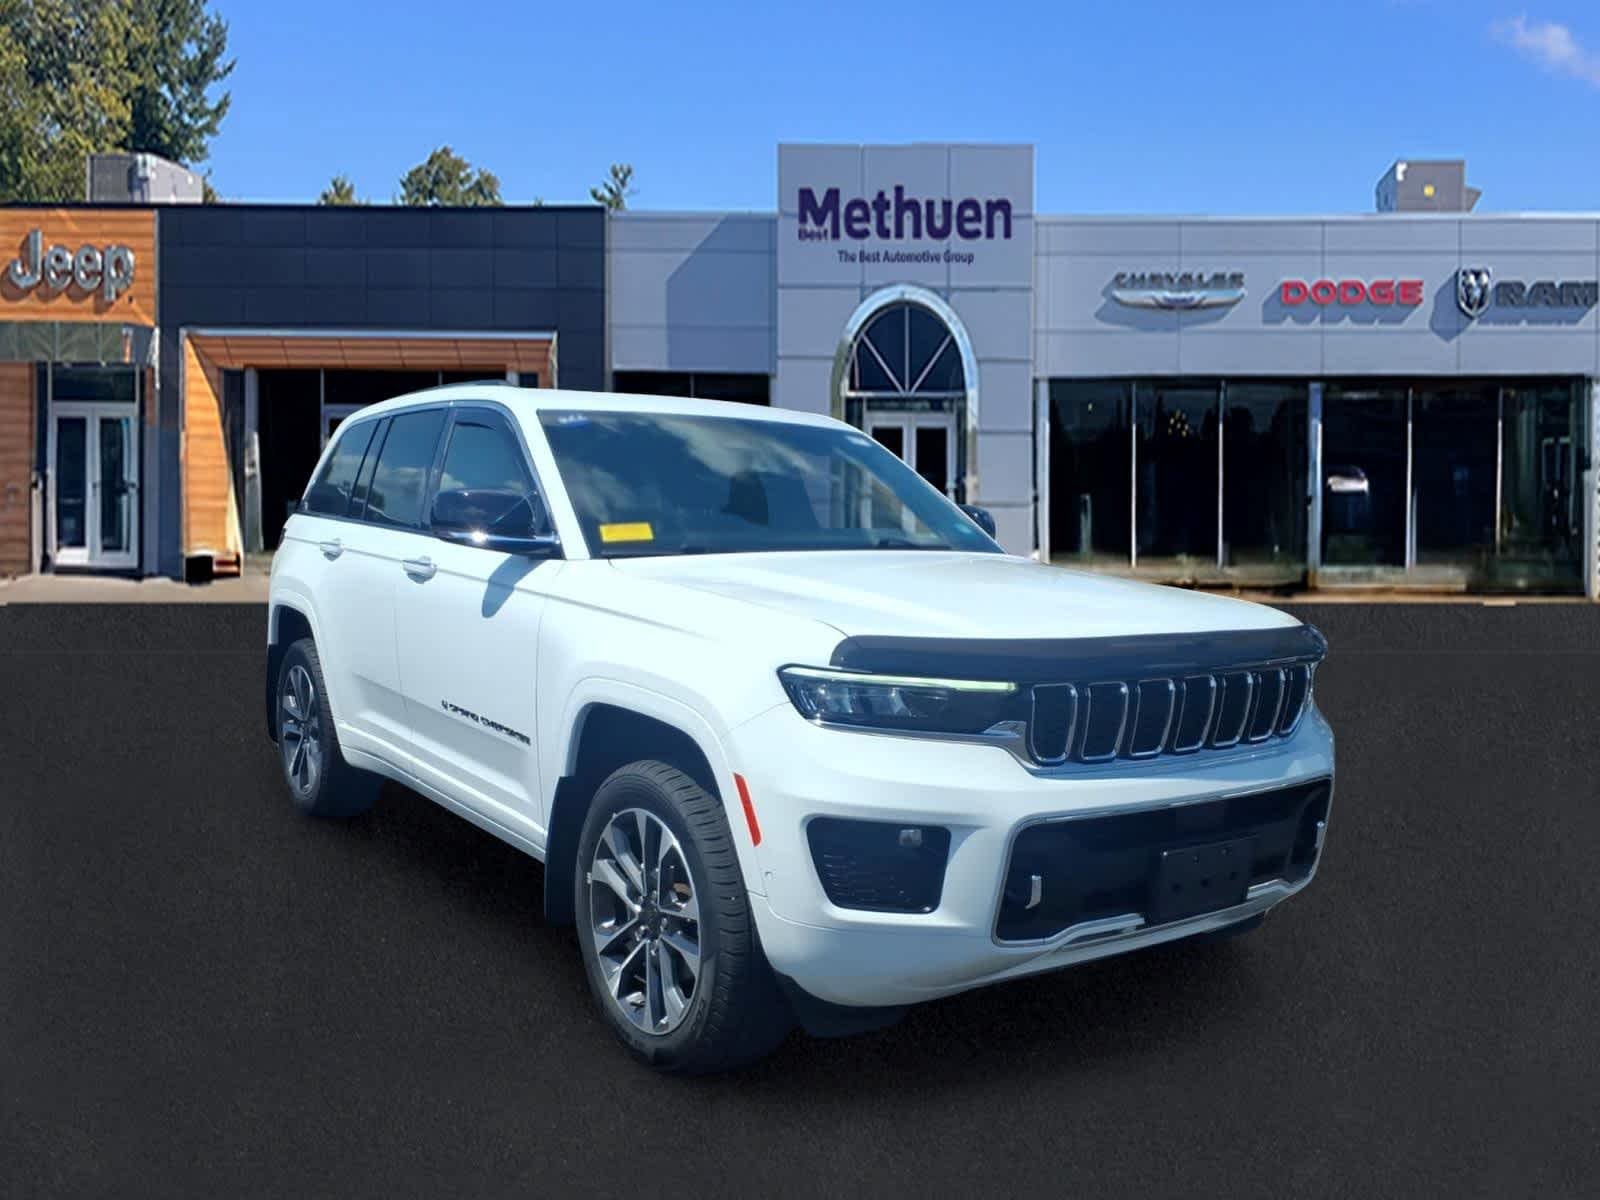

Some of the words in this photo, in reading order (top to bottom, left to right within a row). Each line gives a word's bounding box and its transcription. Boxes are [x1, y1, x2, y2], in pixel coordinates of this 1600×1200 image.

[798, 185, 1012, 240] Methuen
[798, 228, 829, 241] Best
[9, 229, 135, 301] Jeep
[838, 250, 857, 263] The
[859, 250, 880, 263] Best
[883, 250, 940, 263] Automotive
[943, 250, 974, 266] Group
[1281, 280, 1424, 305] DODGE
[1495, 281, 1599, 305] RAM
